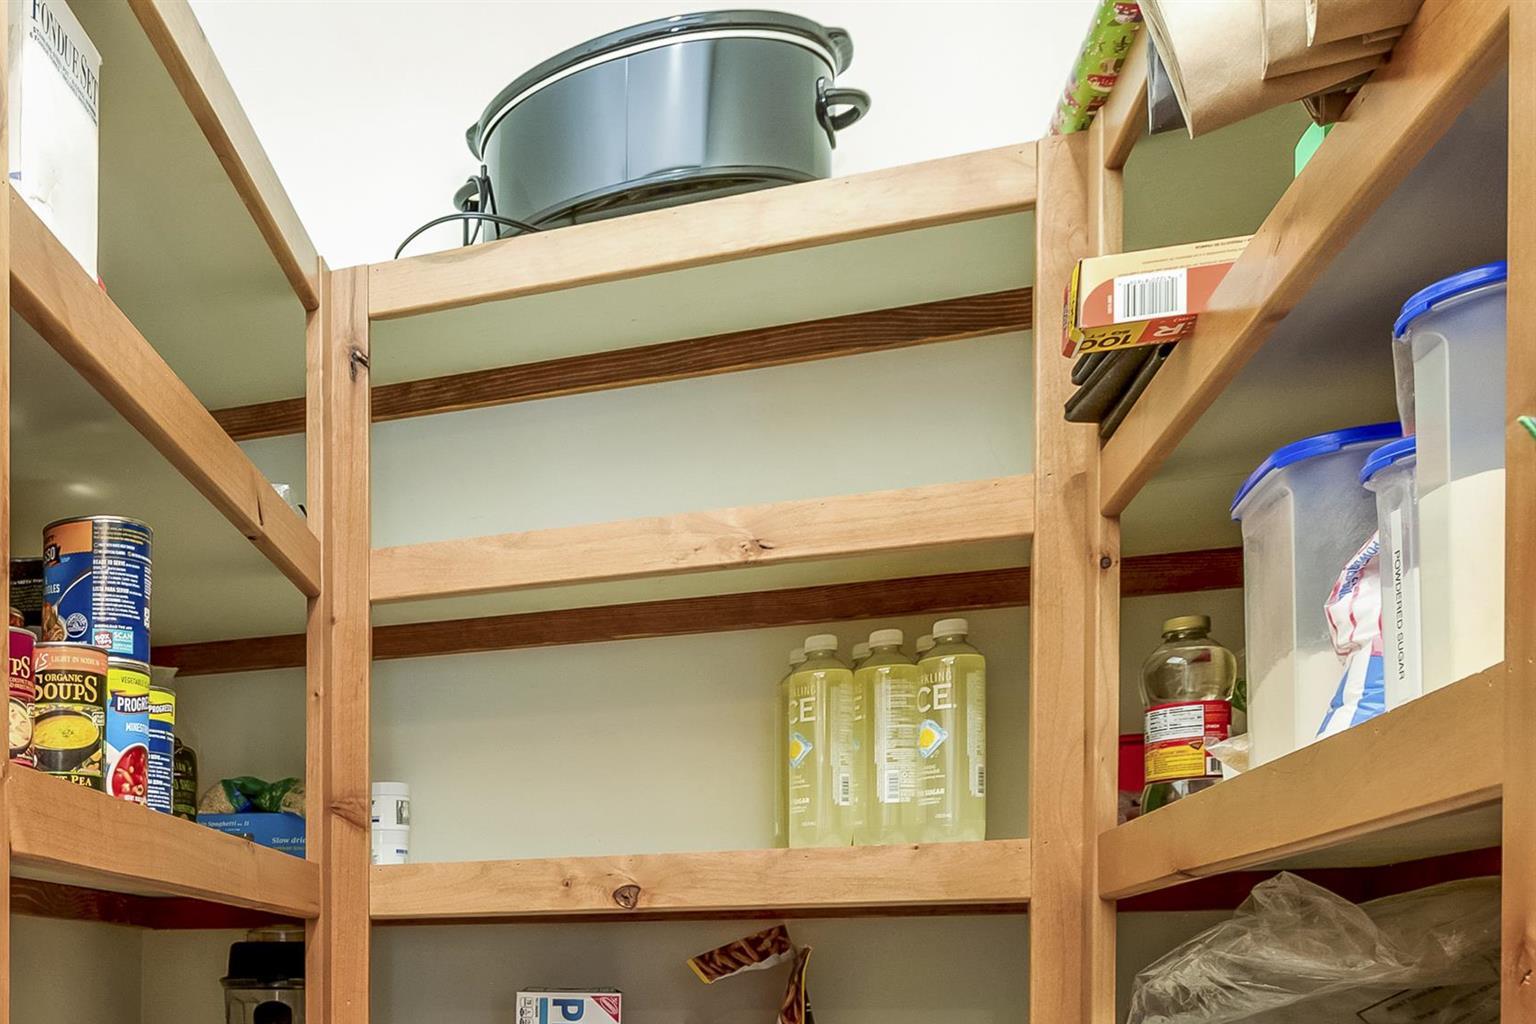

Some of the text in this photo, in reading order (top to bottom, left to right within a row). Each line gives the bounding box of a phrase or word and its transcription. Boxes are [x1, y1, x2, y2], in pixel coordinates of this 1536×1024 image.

[31, 0, 79, 78] FONDUE
[81, 54, 98, 105] SET
[1394, 549, 1405, 680] POWDERED SUGAR
[45, 673, 83, 682] ORGANIC
[72, 773, 91, 787] PEA
